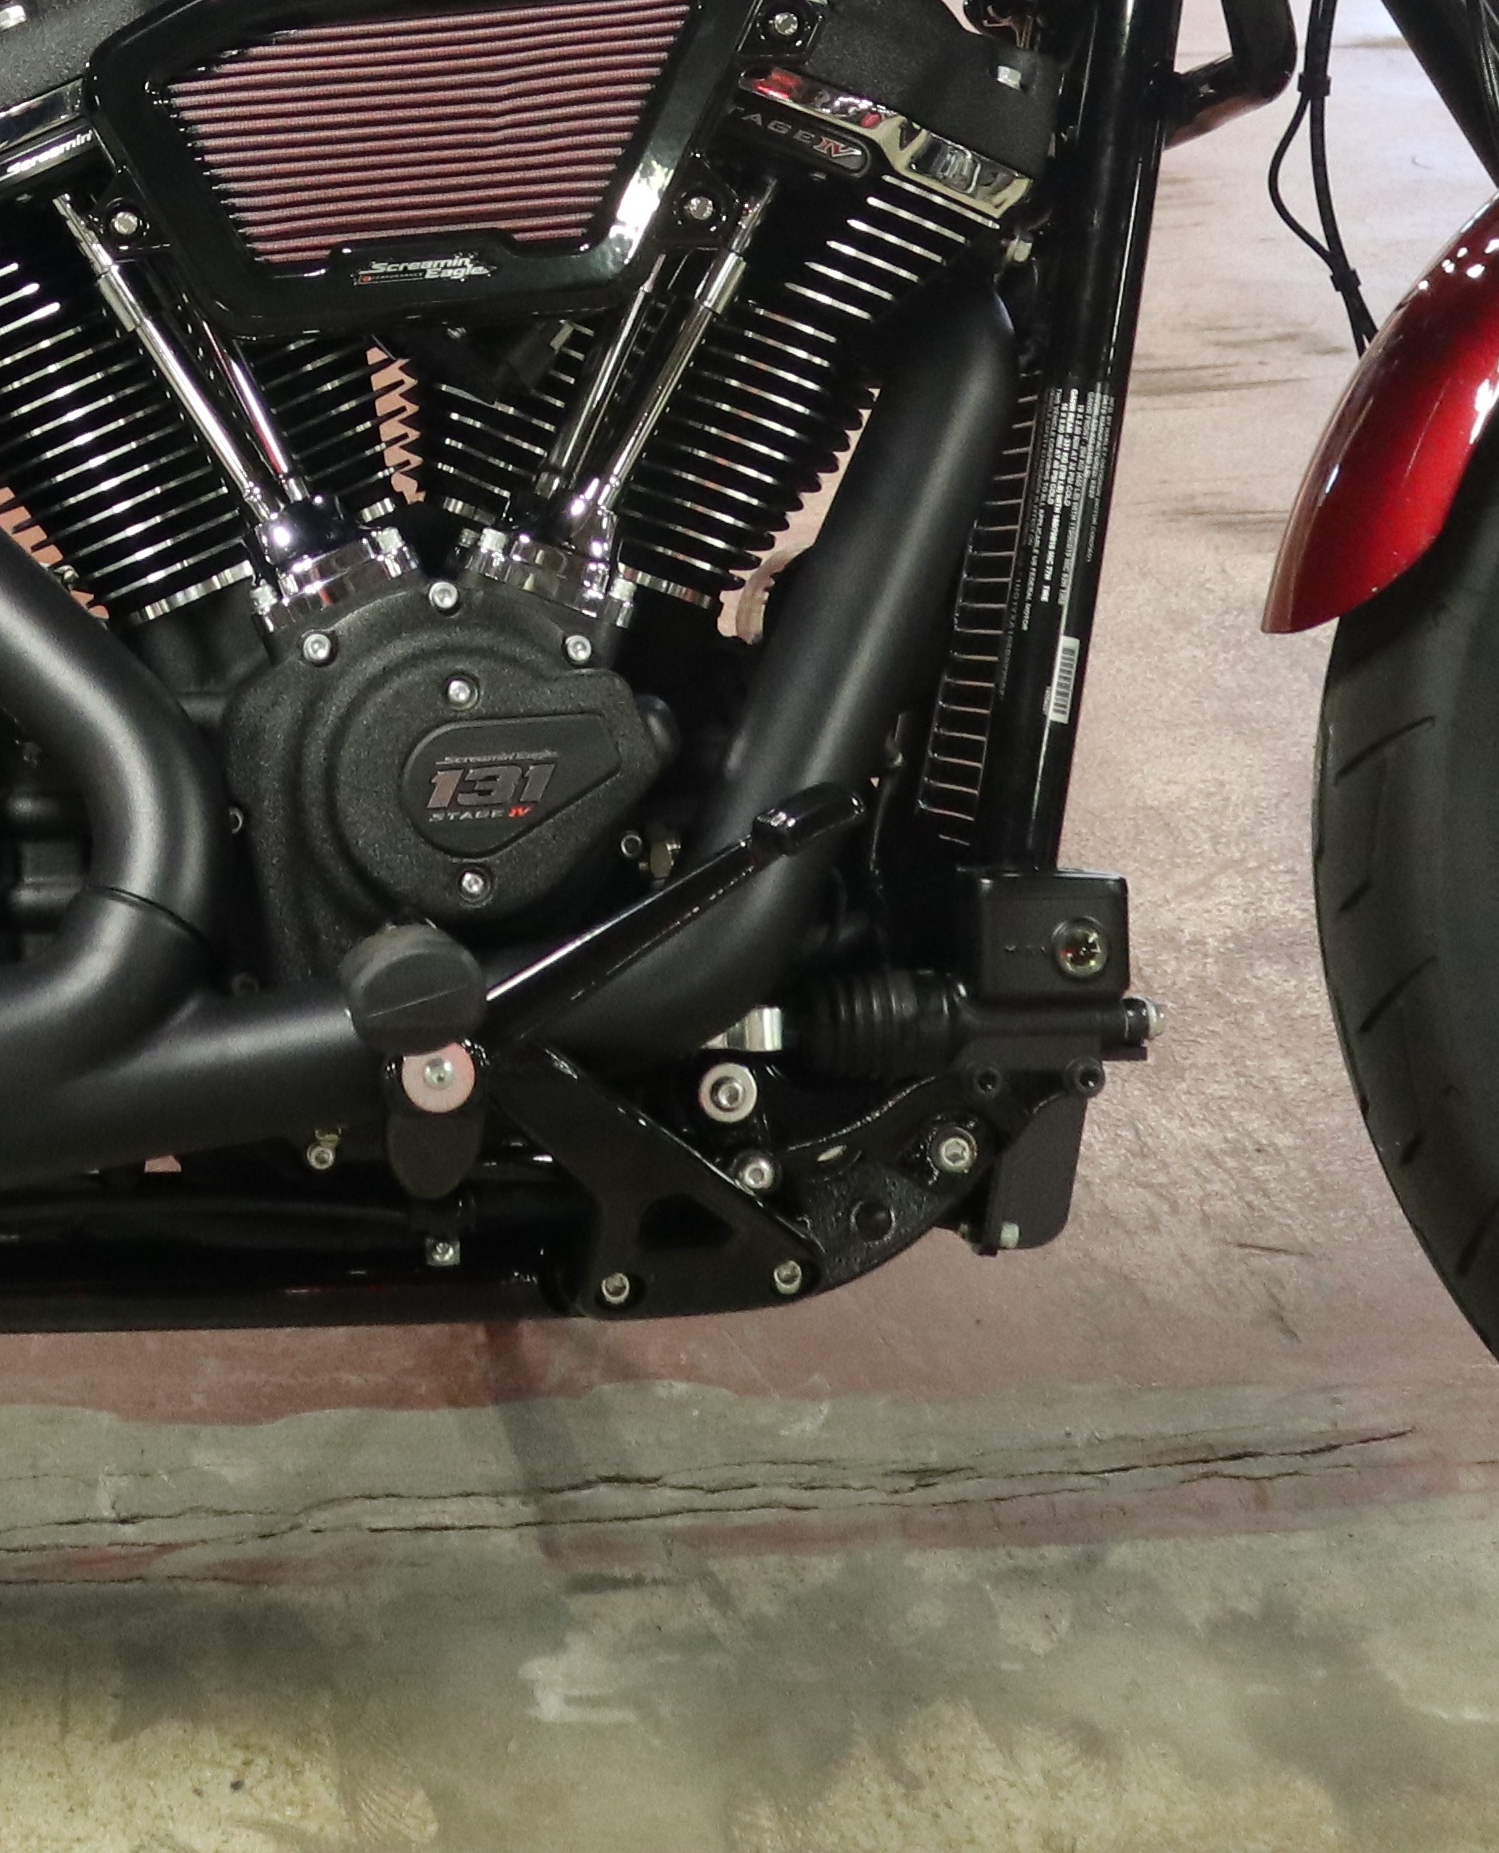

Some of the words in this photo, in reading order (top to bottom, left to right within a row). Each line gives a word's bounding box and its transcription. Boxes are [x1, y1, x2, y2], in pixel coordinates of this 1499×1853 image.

[424, 265, 490, 280] Eagle
[1046, 483, 1056, 505] COLD
[1063, 484, 1073, 506] COLD
[1032, 509, 1044, 554] APPLICABLE
[1025, 567, 1036, 600] FEDERAL
[1021, 602, 1031, 631] MOTOR
[427, 763, 556, 808] 131
[429, 809, 505, 823] STAGE
[508, 805, 536, 818] IV
